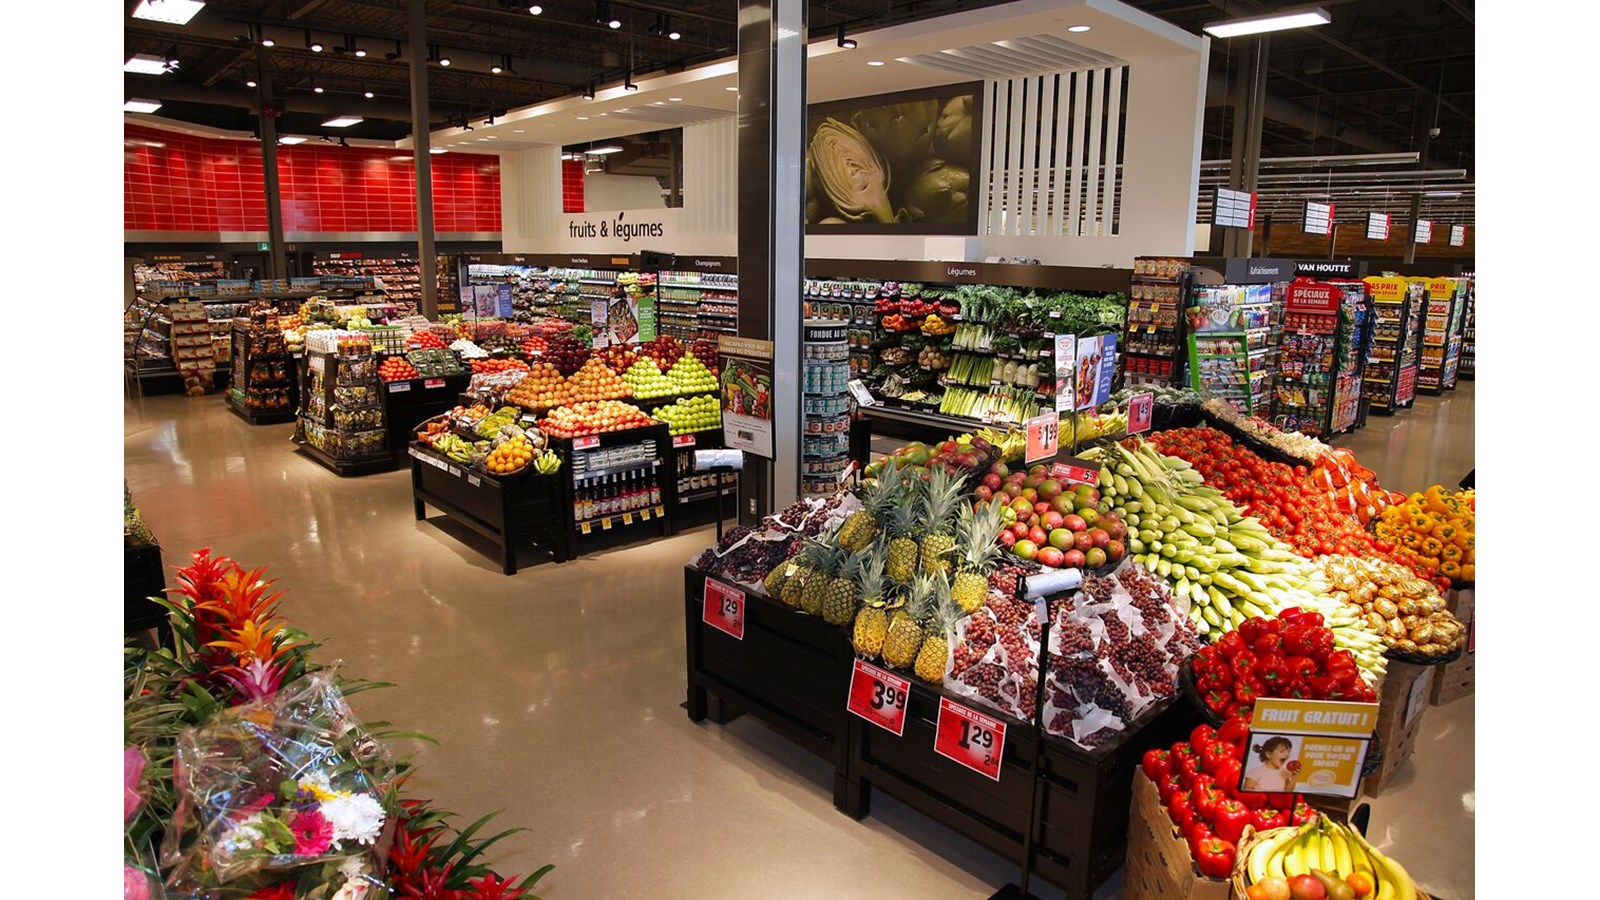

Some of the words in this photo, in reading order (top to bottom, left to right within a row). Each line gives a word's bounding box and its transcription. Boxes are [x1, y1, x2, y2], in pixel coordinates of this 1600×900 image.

[569, 221, 597, 238] fruits
[600, 220, 609, 238] &
[613, 211, 664, 242] légumes
[947, 267, 976, 277] Légumes
[1297, 263, 1315, 271] VAN
[1316, 263, 1351, 273] HOUTTE
[1293, 289, 1330, 299] SPÉCIAUX
[810, 329, 833, 339] FONDUE
[1261, 708, 1300, 723] FRUIT
[1303, 710, 1361, 725] GRATUIT
[1361, 713, 1369, 726] !
